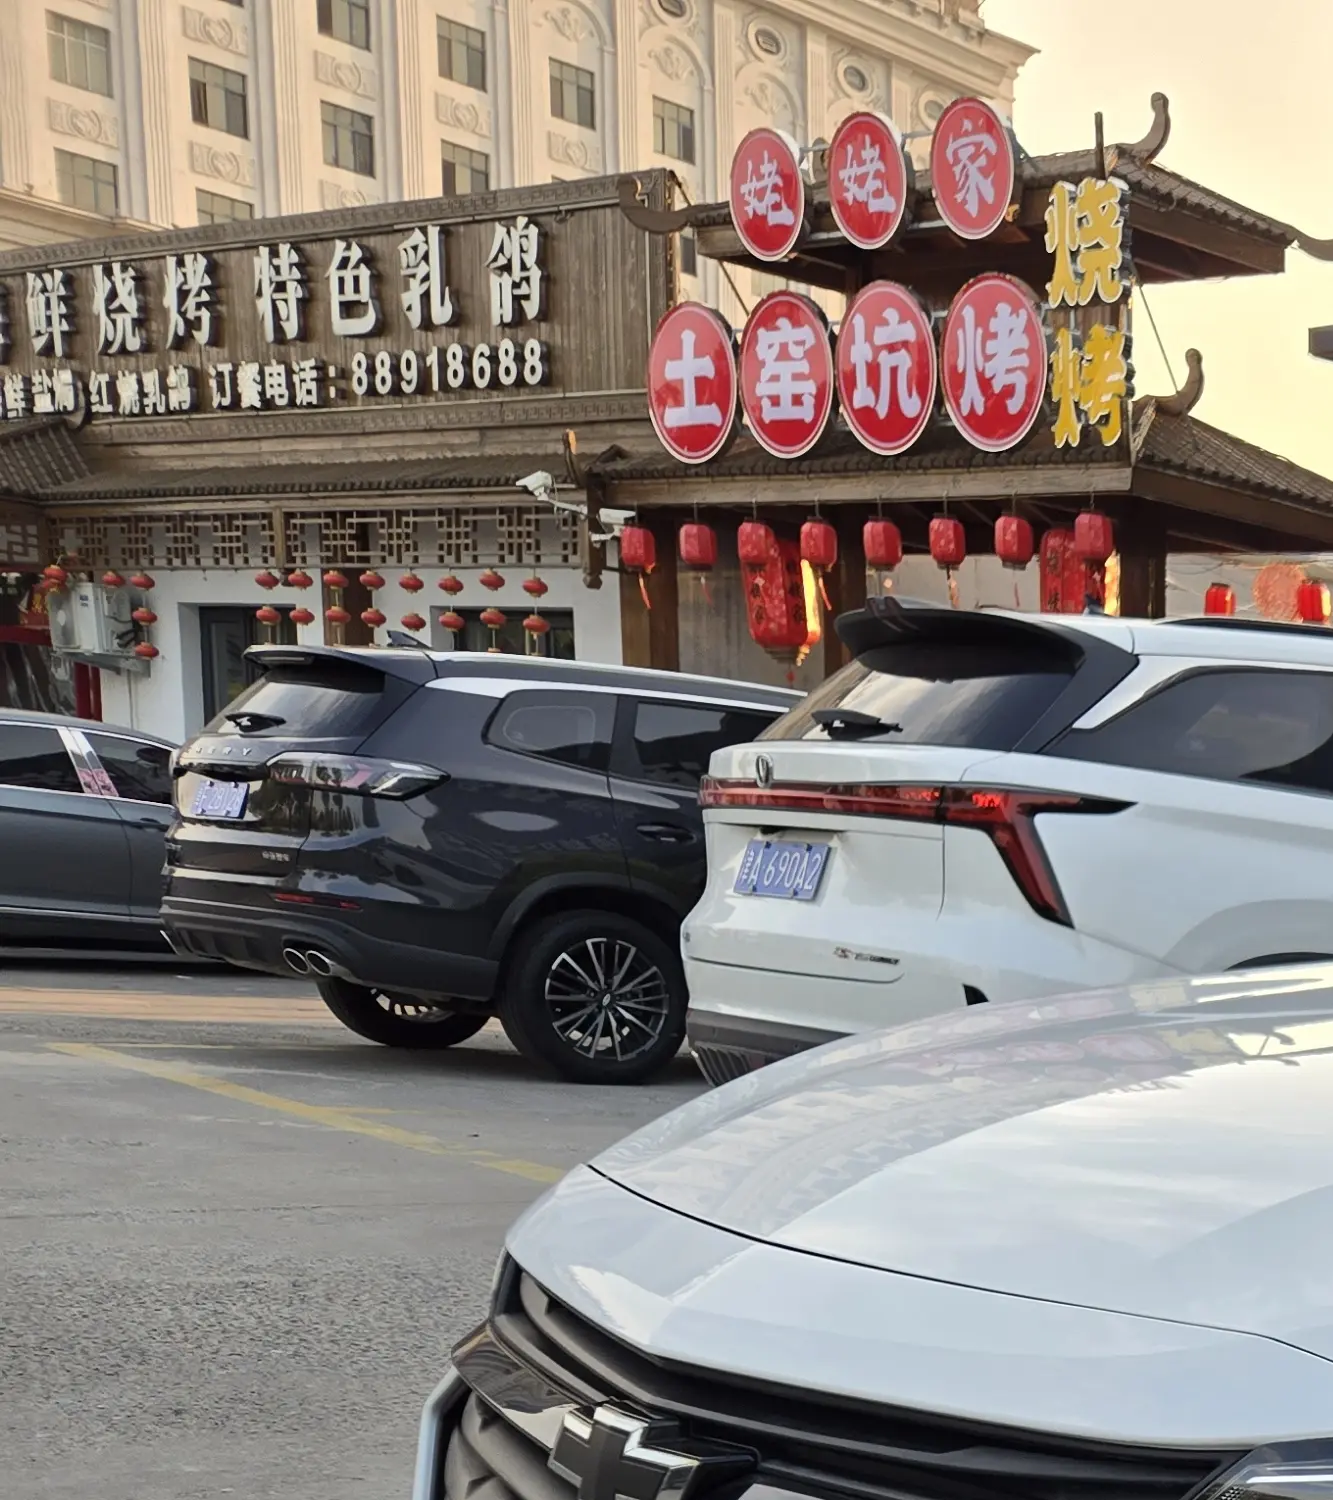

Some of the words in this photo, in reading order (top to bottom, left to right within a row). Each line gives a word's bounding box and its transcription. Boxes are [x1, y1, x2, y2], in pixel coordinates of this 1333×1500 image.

[740, 119, 997, 227] 姥姥家
[0, 252, 212, 358] 鲜烧烤
[253, 216, 542, 342] 特色乳鸽
[1044, 176, 1128, 449] 烧烤
[89, 364, 191, 415] 红烧乳鸽
[664, 301, 1031, 428] 土窑坑烤
